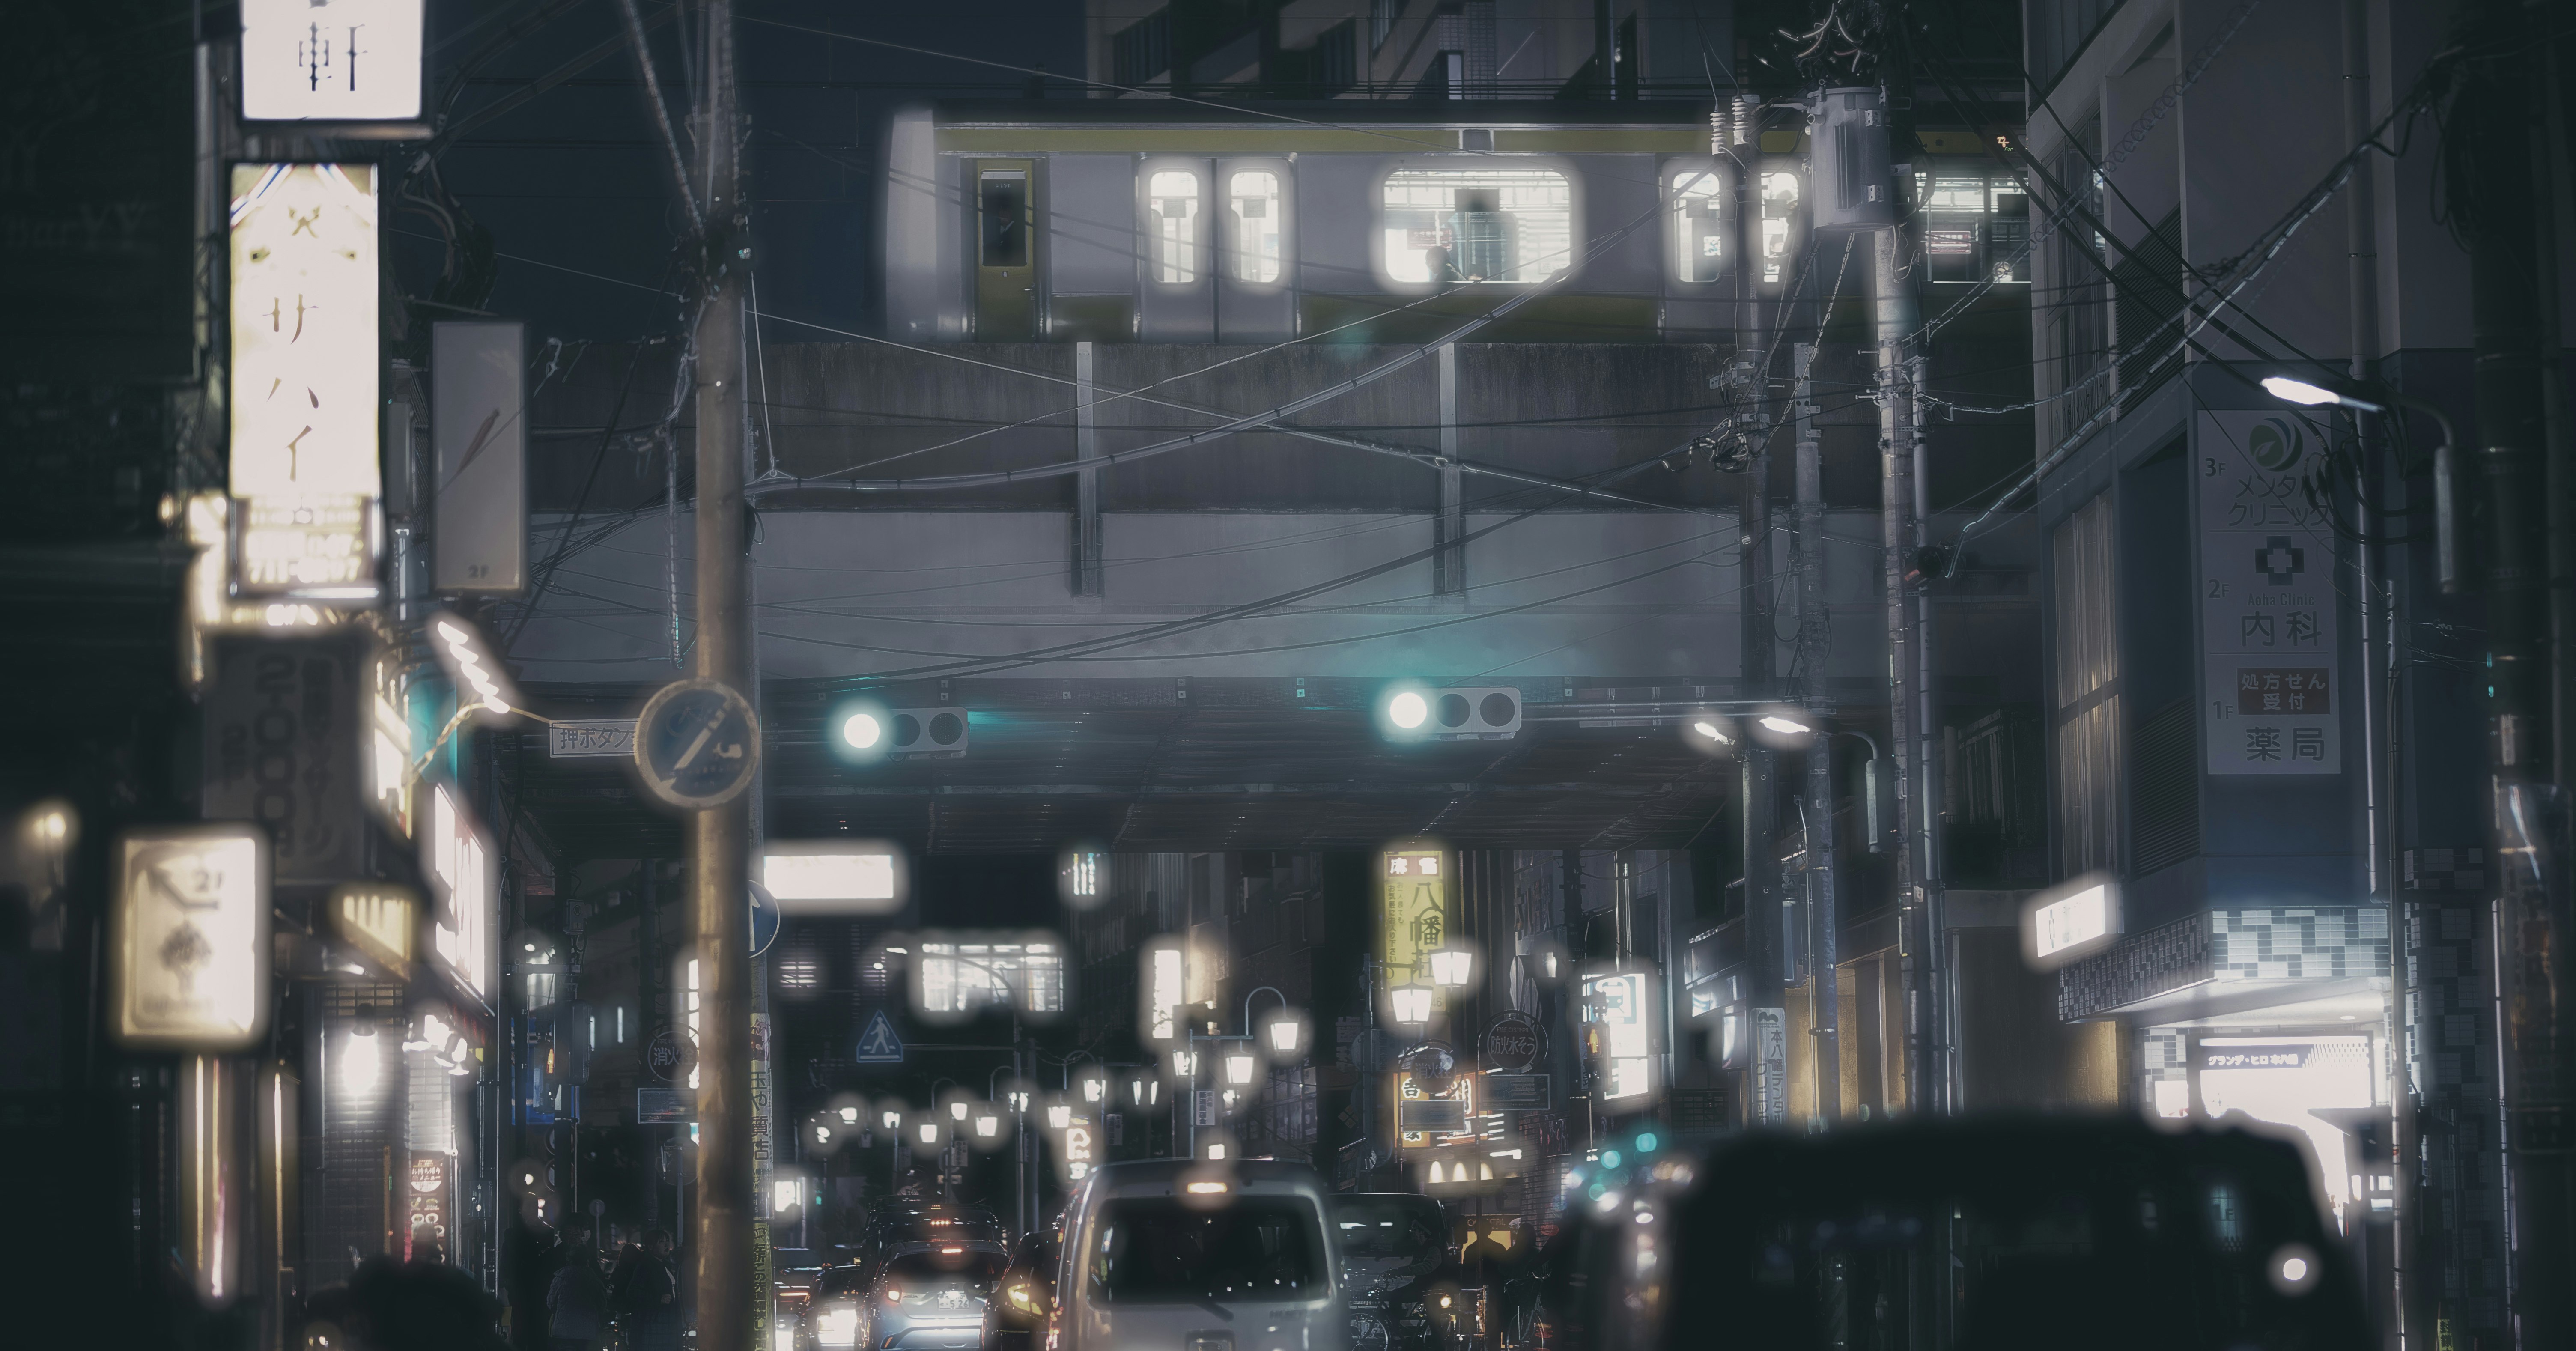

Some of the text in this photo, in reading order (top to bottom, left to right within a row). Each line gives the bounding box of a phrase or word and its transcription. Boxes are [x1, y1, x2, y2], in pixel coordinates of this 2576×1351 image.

[298, 0, 368, 91] 軒
[2205, 458, 2226, 476] 3F
[2228, 502, 2328, 526] クリニック
[2208, 579, 2229, 598] 2F
[2280, 593, 2315, 606] Clinic
[2241, 611, 2322, 647] 内科
[2241, 674, 2326, 690] 処方せん
[2212, 701, 2233, 720] 1F
[2263, 694, 2305, 710] 受付
[560, 727, 636, 749] 押ボタン
[2245, 726, 2325, 761] 薬局
[1491, 1036, 1535, 1055] 防火水そう
[654, 1047, 694, 1065] 消火栓
